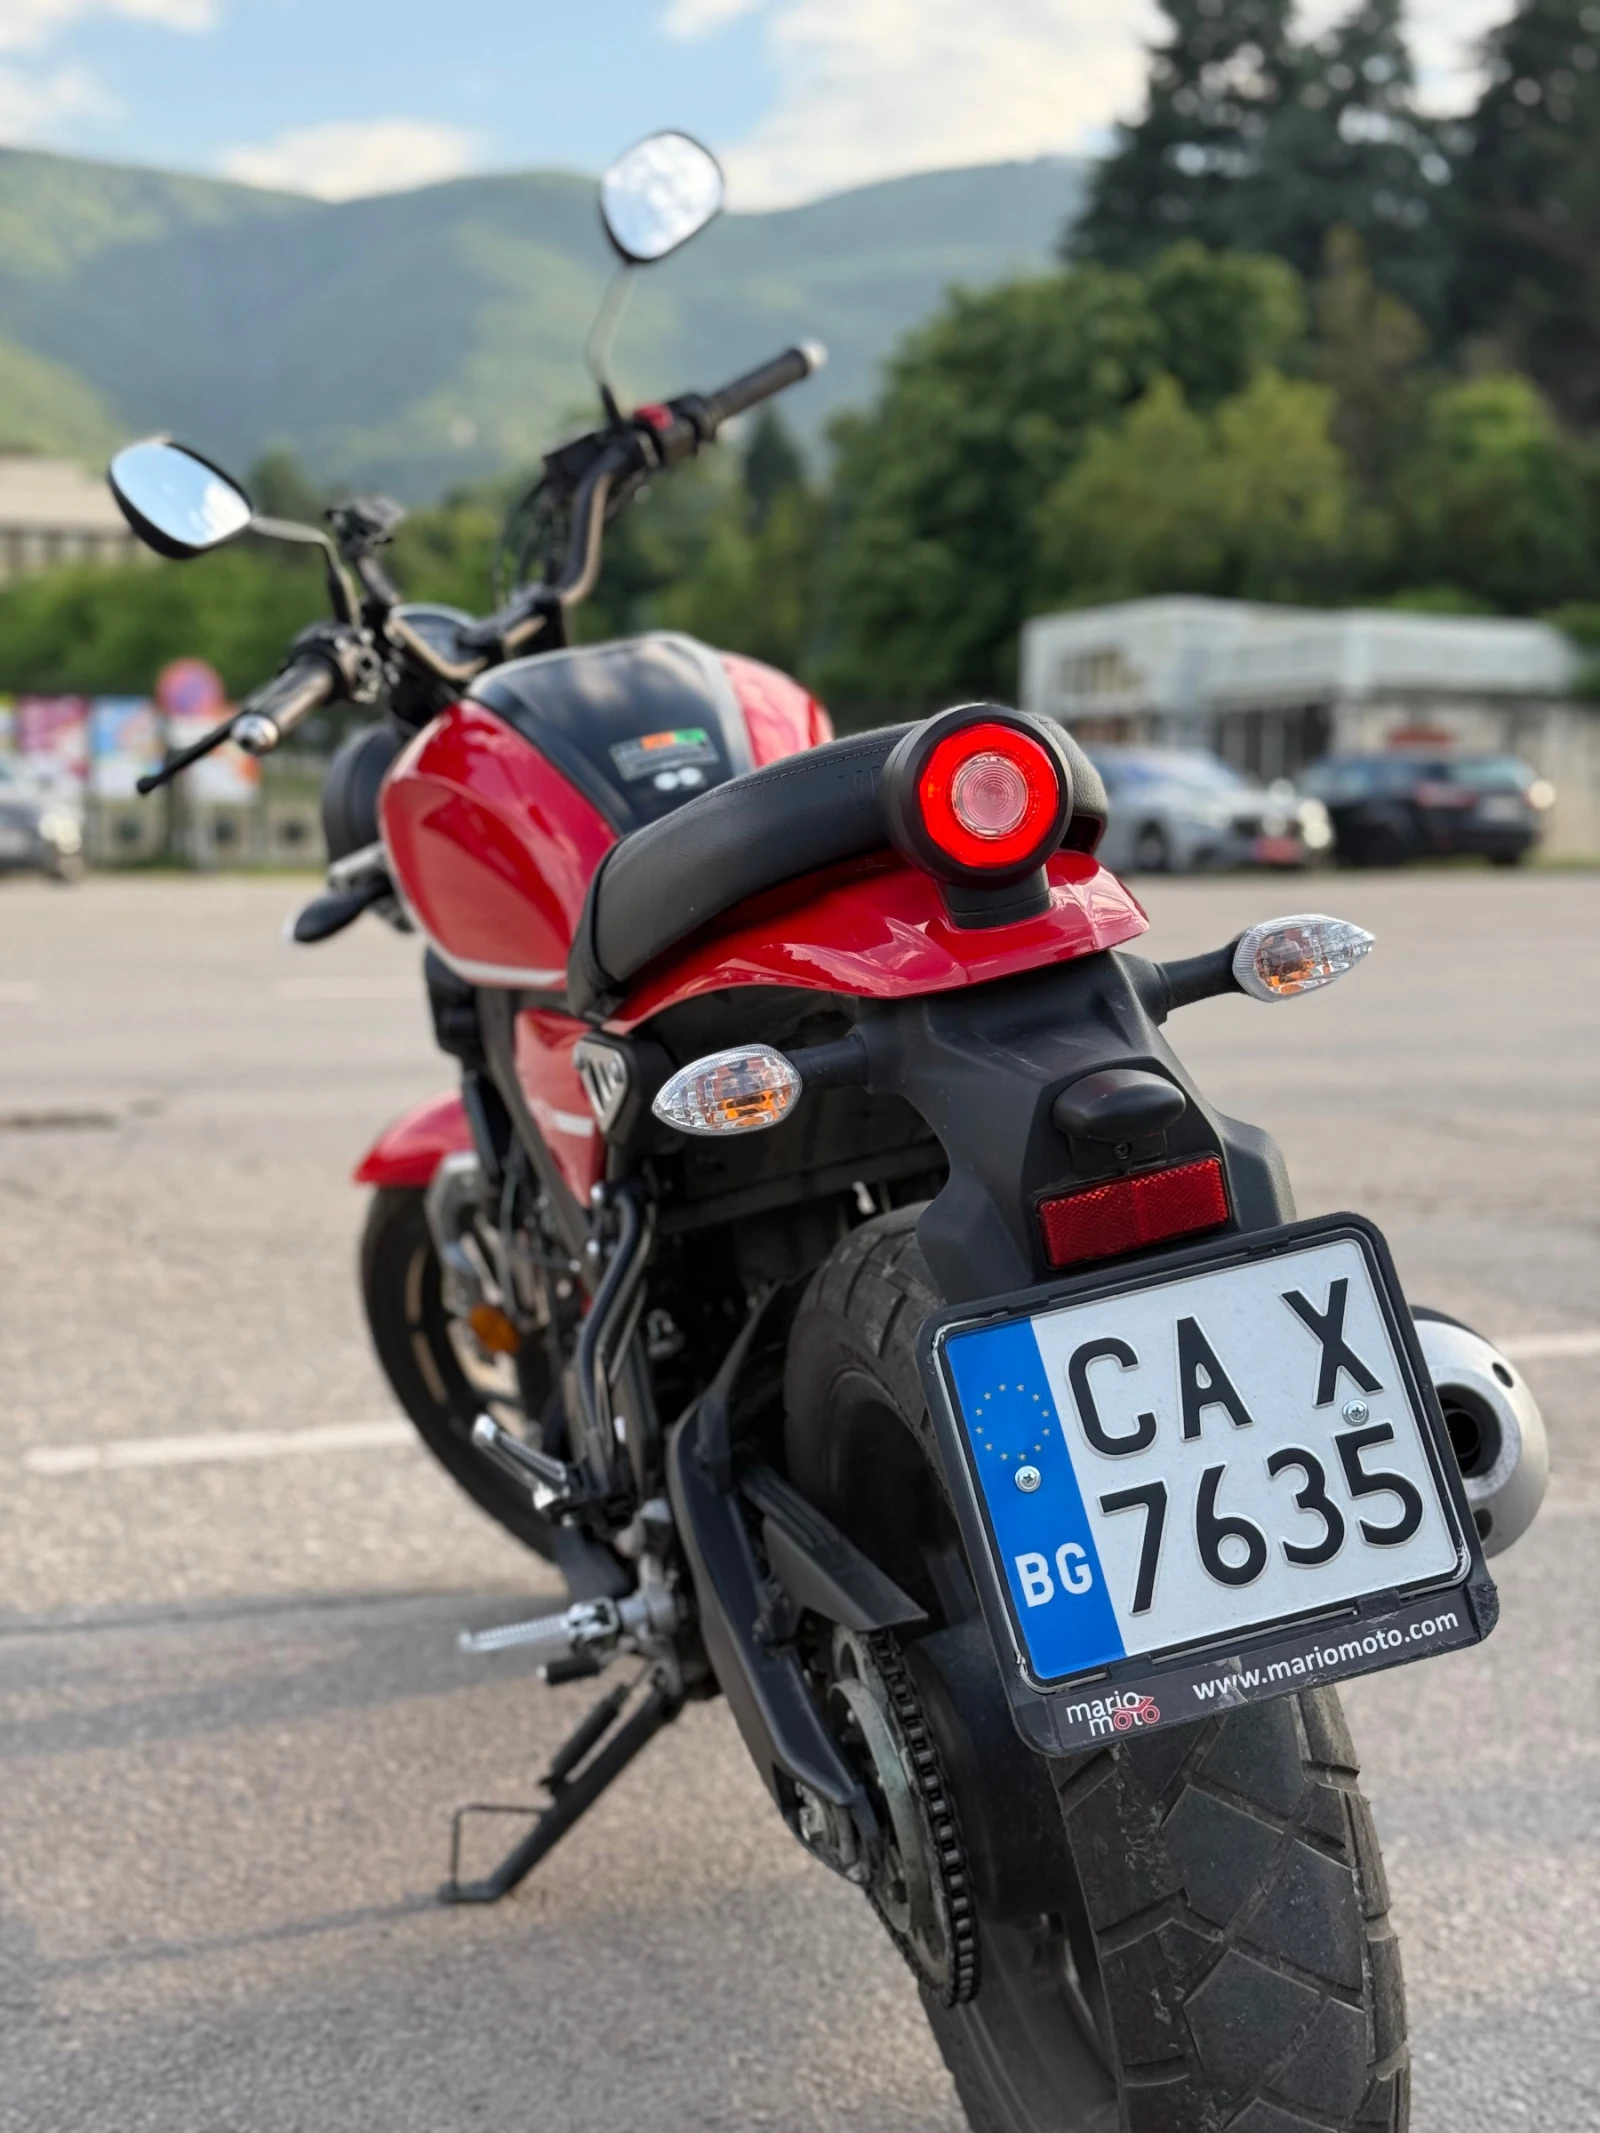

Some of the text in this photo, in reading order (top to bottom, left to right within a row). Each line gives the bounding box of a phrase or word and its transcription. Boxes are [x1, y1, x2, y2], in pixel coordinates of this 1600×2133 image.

[1068, 1277, 1383, 1456] CA X
[1099, 1422, 1424, 1614] 7635
[1014, 1542, 1093, 1608] BG
[1192, 1610, 1460, 1702] www.mariomoto.com
[1066, 1690, 1140, 1724] mario
[1089, 1704, 1160, 1736] moto
